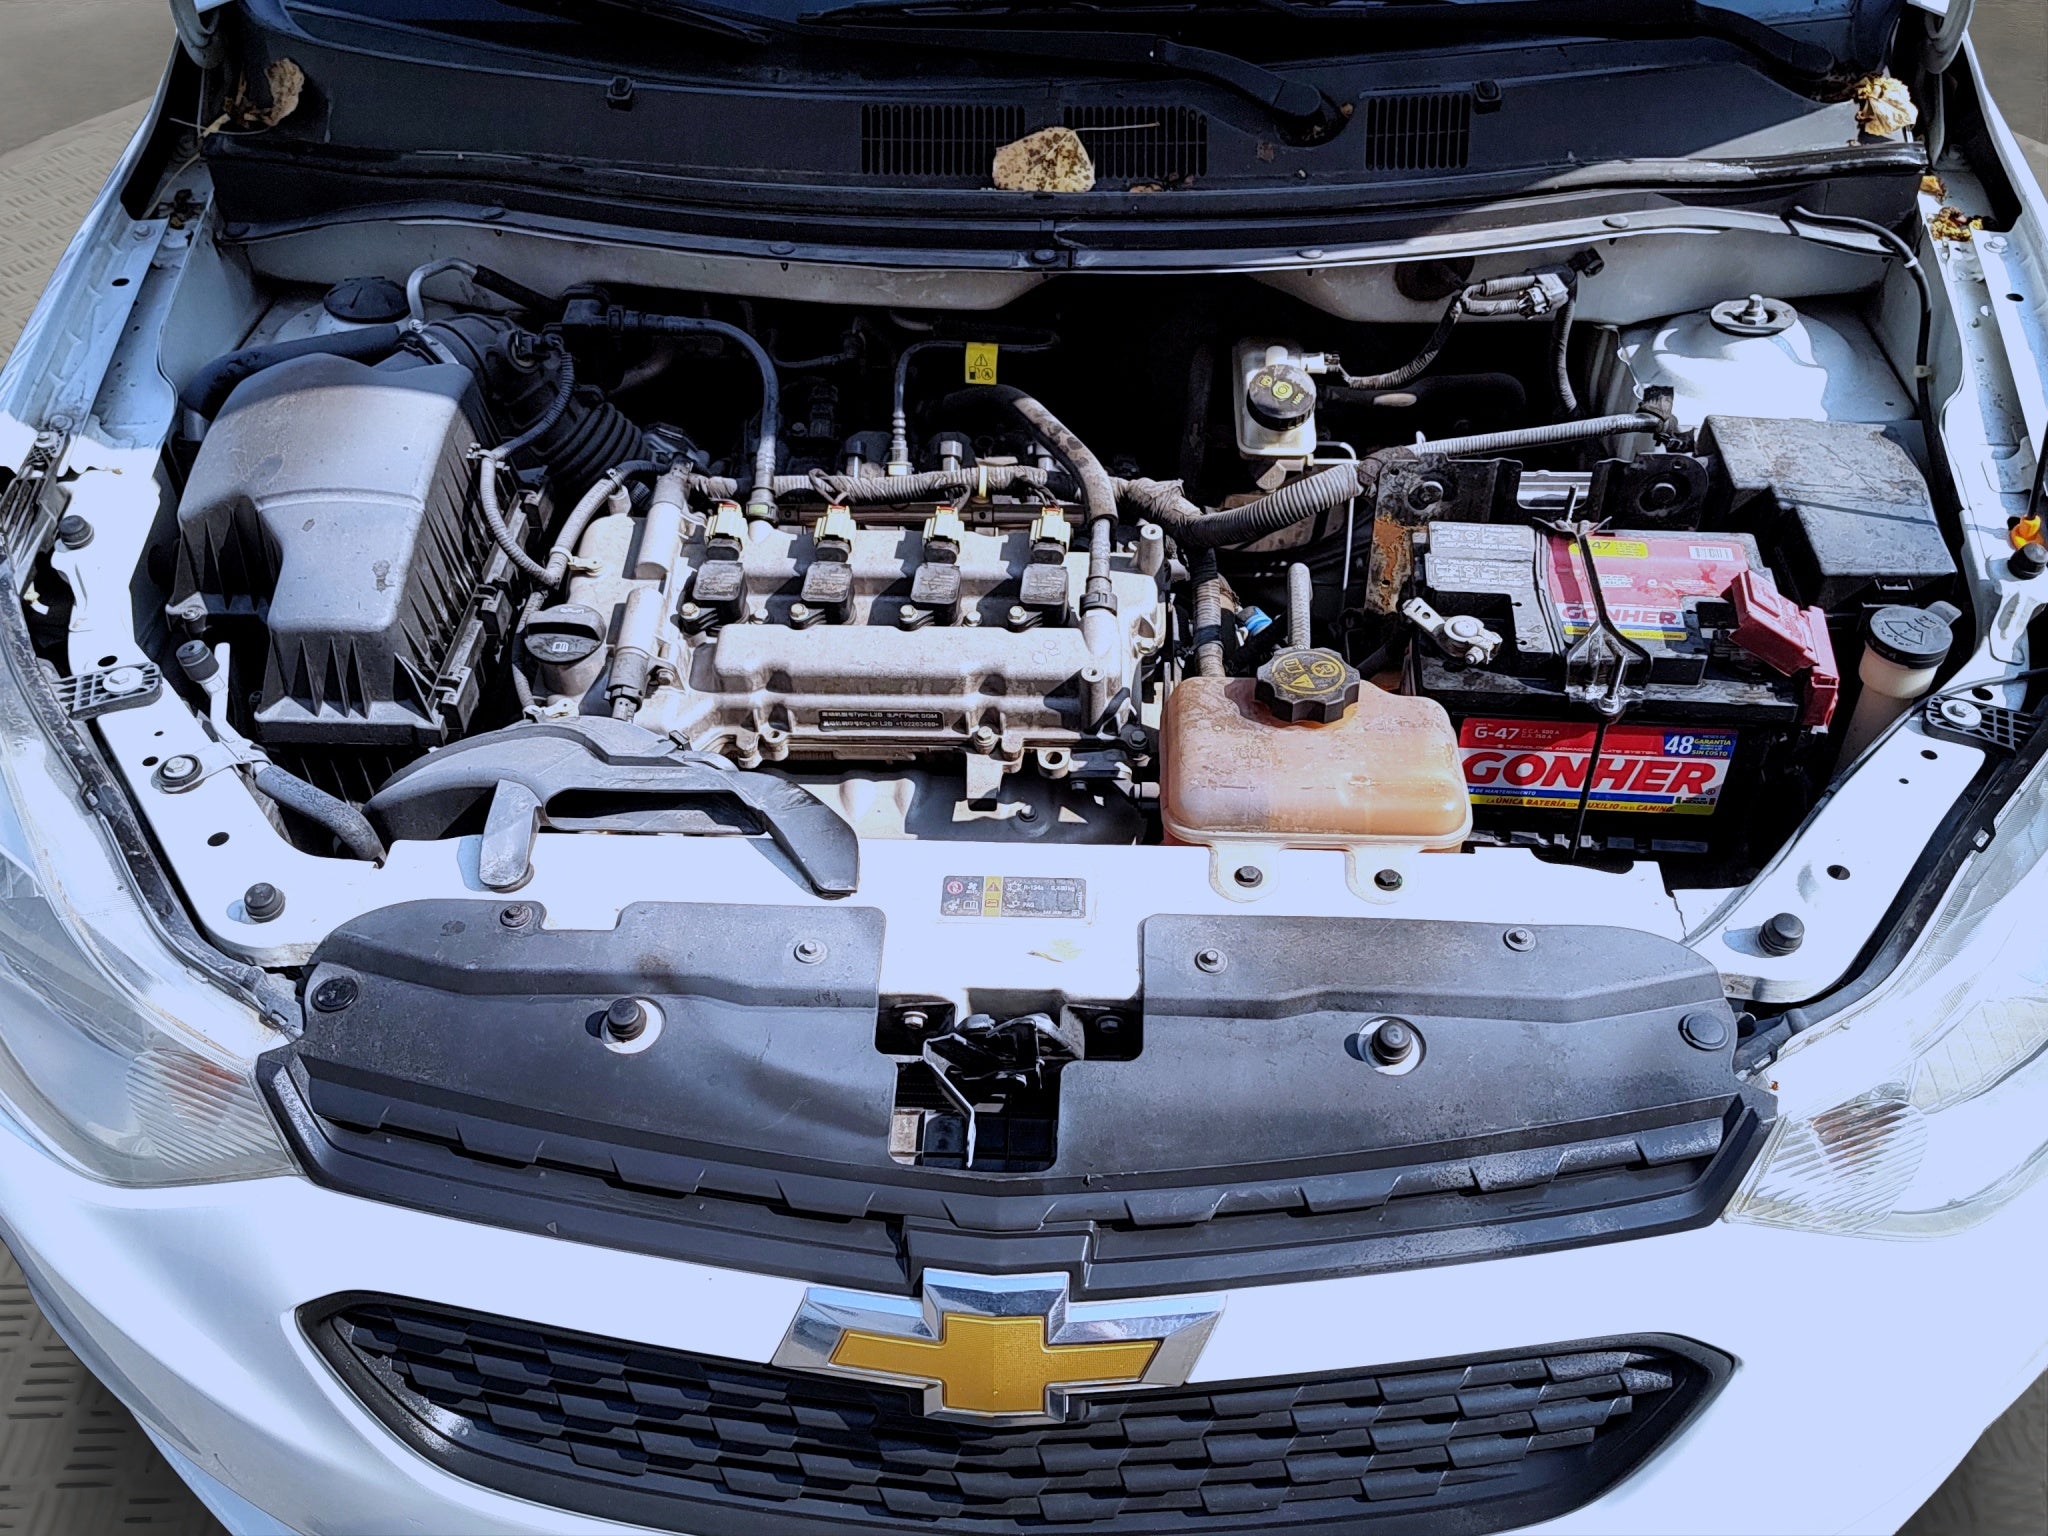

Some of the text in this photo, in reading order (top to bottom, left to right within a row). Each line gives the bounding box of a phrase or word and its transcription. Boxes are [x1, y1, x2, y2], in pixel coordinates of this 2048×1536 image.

[1475, 726, 1520, 740] G-47
[1664, 735, 1694, 754] 48
[1462, 751, 1716, 795] GONHER
